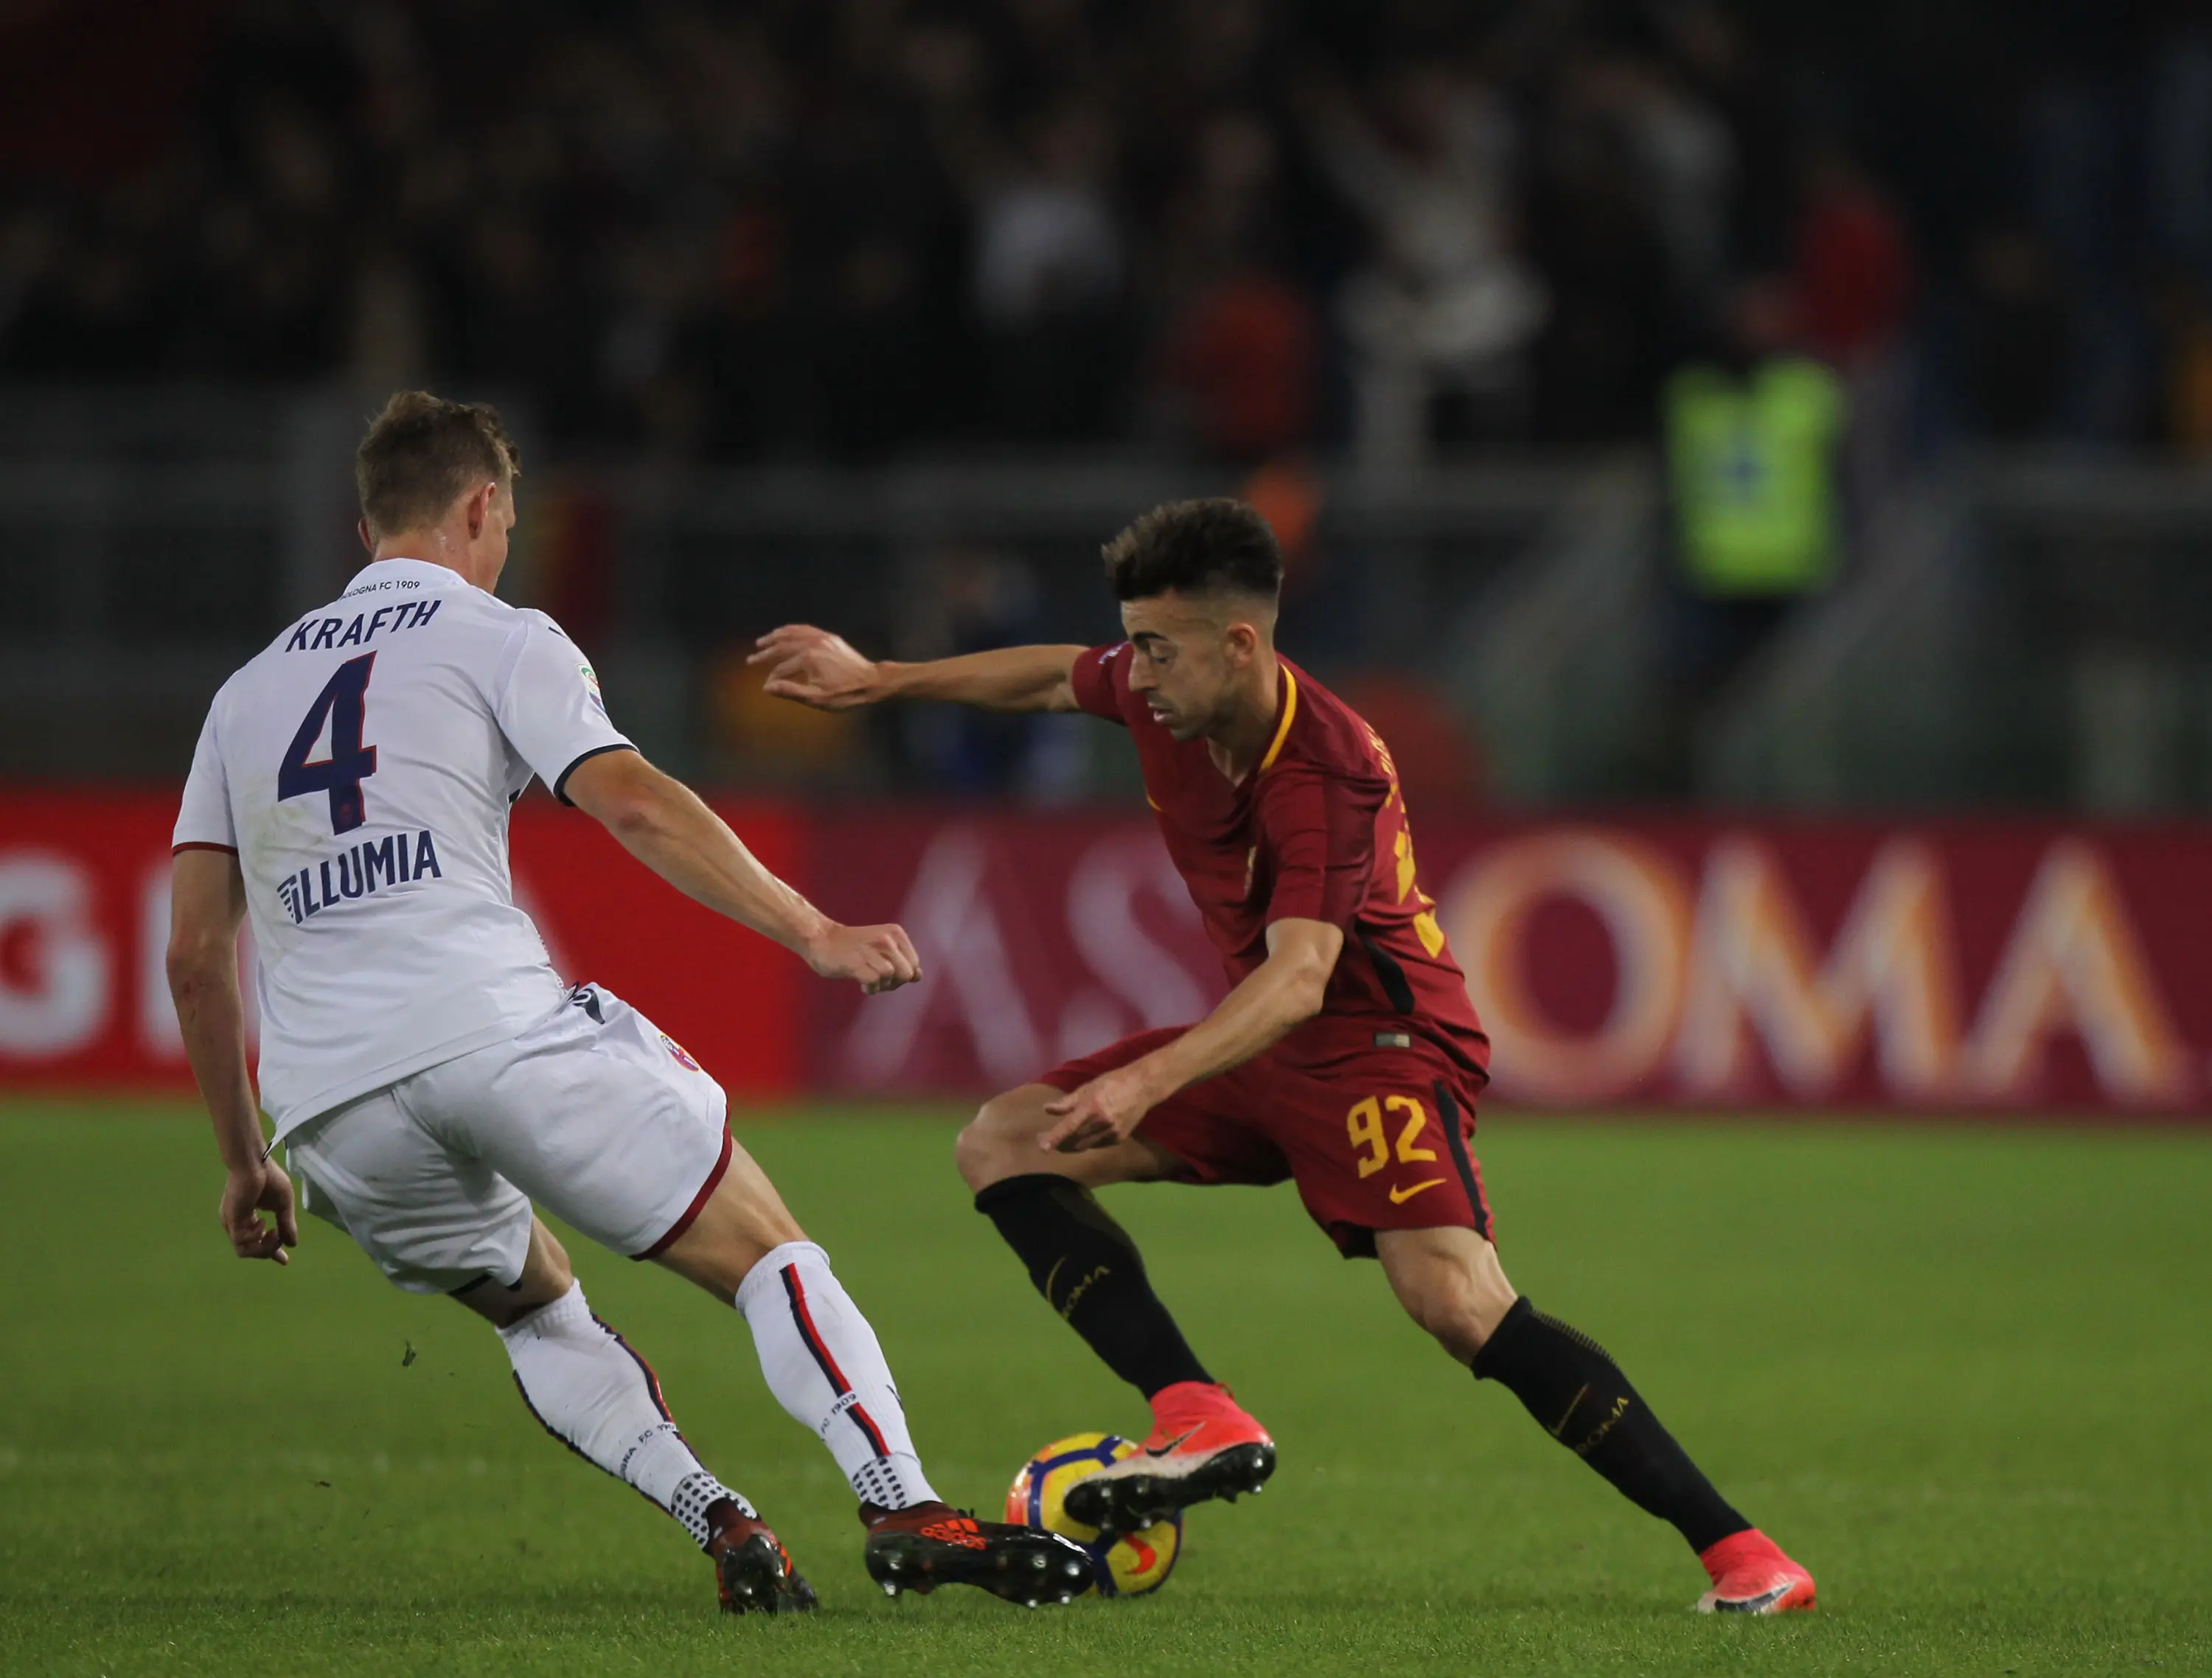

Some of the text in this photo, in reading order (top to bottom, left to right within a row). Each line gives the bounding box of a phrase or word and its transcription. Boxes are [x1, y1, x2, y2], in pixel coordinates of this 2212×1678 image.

[285, 599, 442, 652] KRAFTH
[379, 582, 392, 590] FC
[396, 580, 420, 589] 1909
[277, 650, 377, 836] 4
[277, 829, 442, 925] ILLUMIA
[1444, 826, 2179, 1100] OMA
[1347, 1095, 1437, 1179] 92
